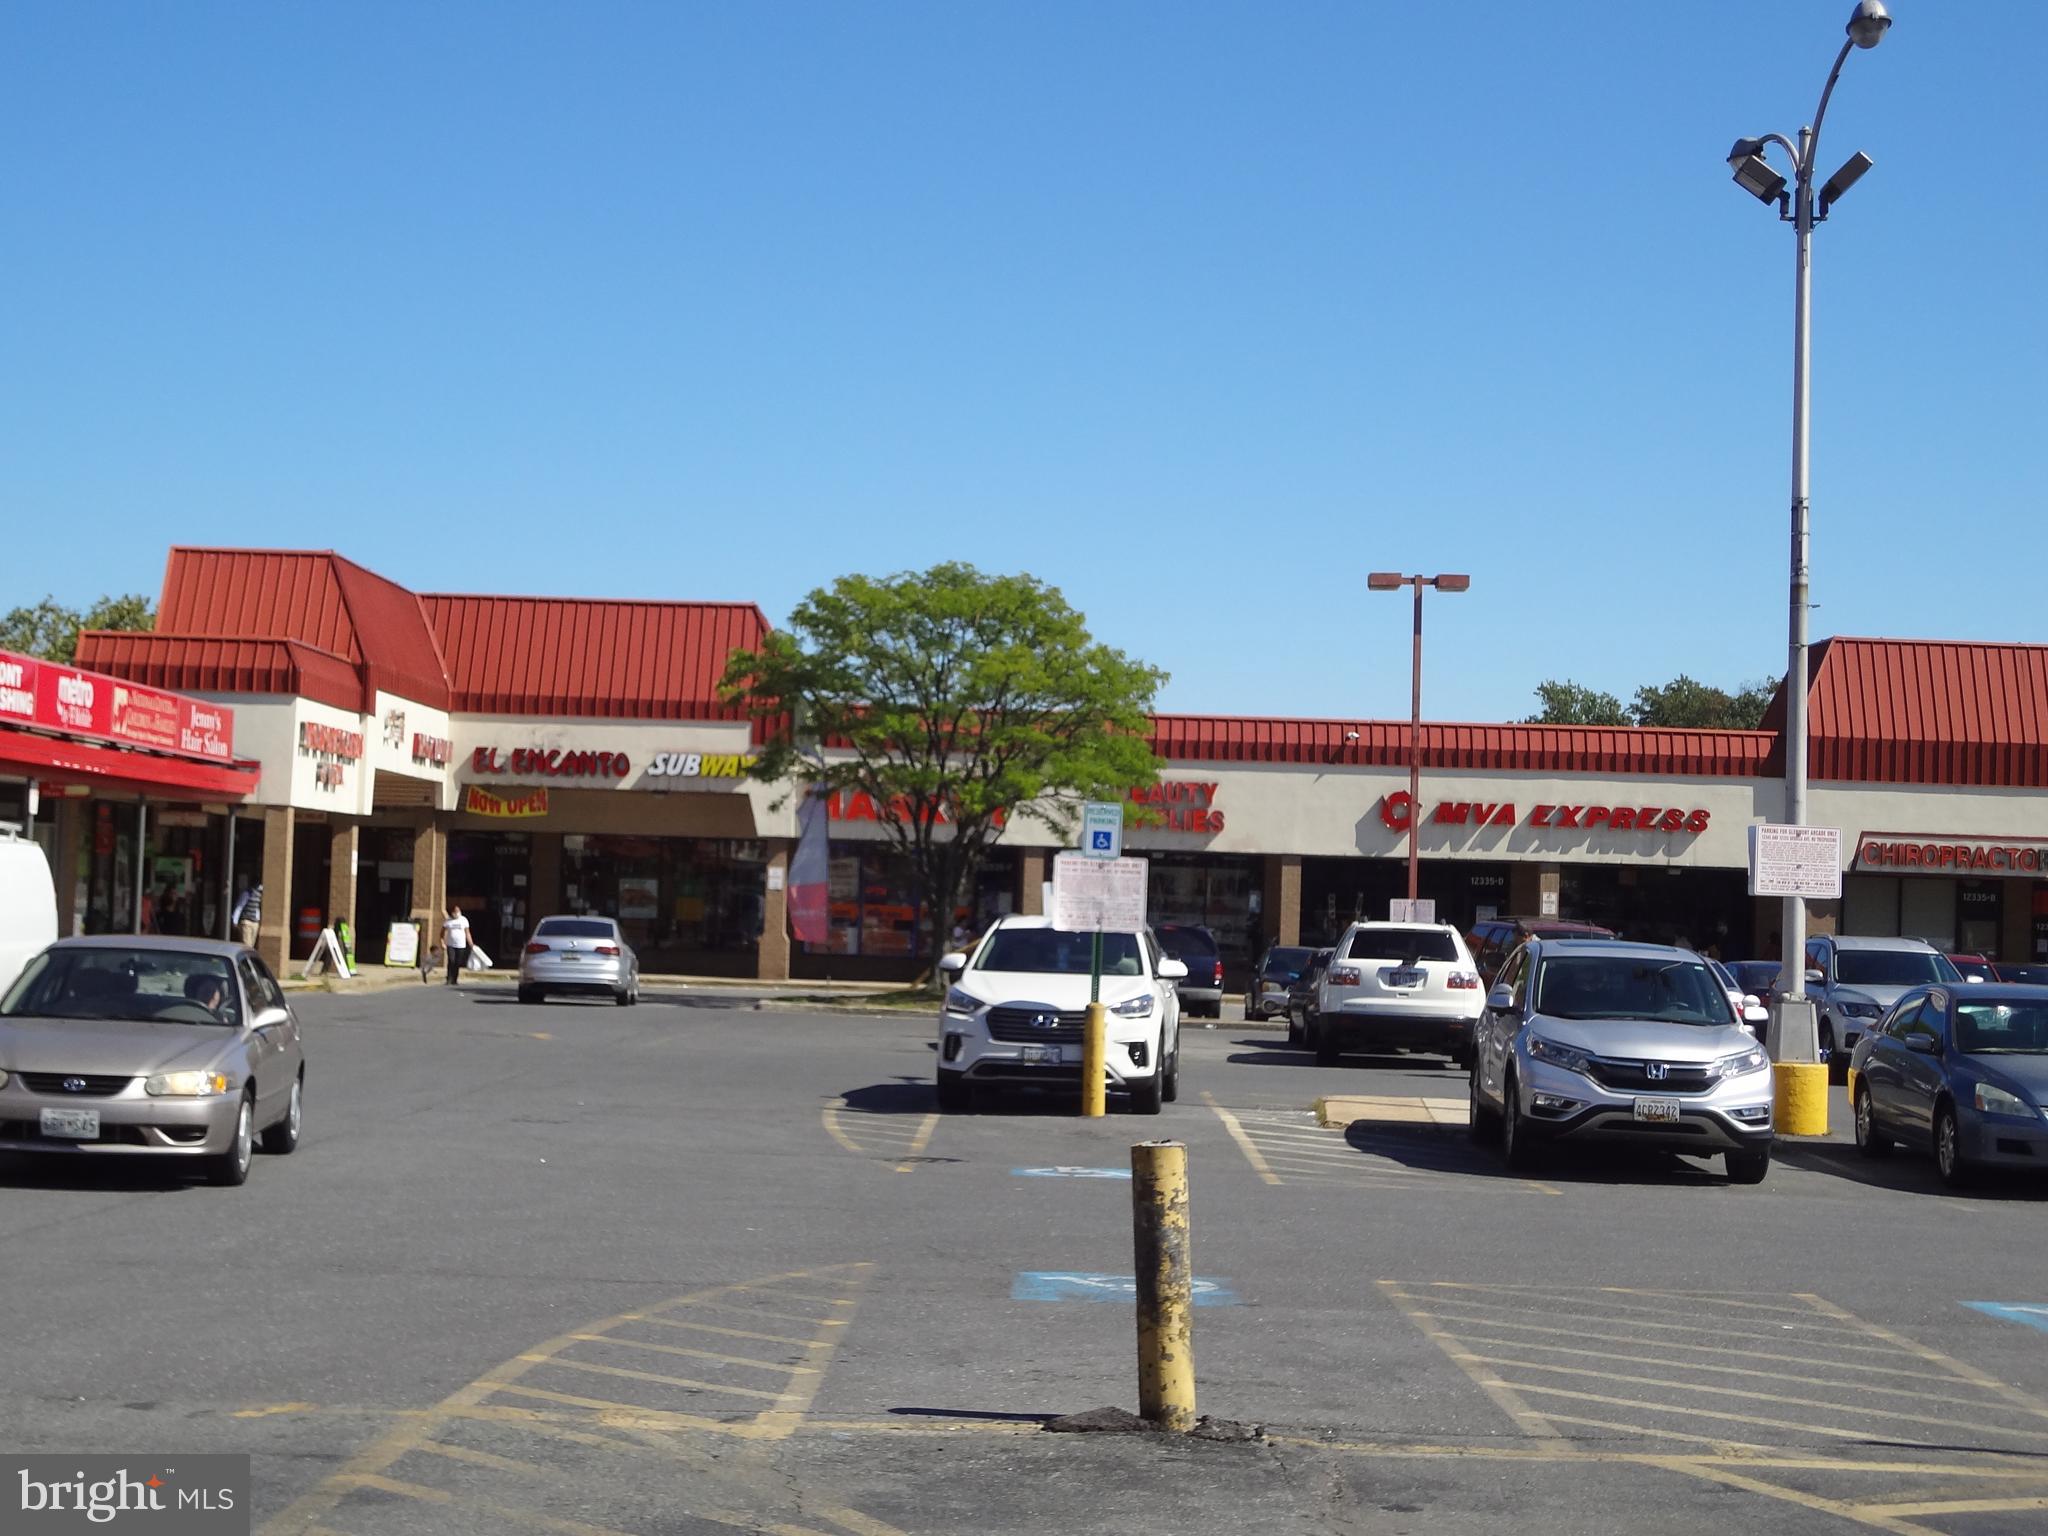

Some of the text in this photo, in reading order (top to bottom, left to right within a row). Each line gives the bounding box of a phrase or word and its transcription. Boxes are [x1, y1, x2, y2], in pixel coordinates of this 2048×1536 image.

[58, 673, 94, 708] metro
[181, 727, 202, 752] Hair
[472, 747, 506, 774] EL
[511, 748, 630, 778] ENCANTO
[648, 752, 758, 777] SUBWAY
[468, 787, 547, 813] NOW OPEN
[1128, 782, 1218, 804] EAUTY
[1434, 802, 1711, 833] MVA EXPRESS
